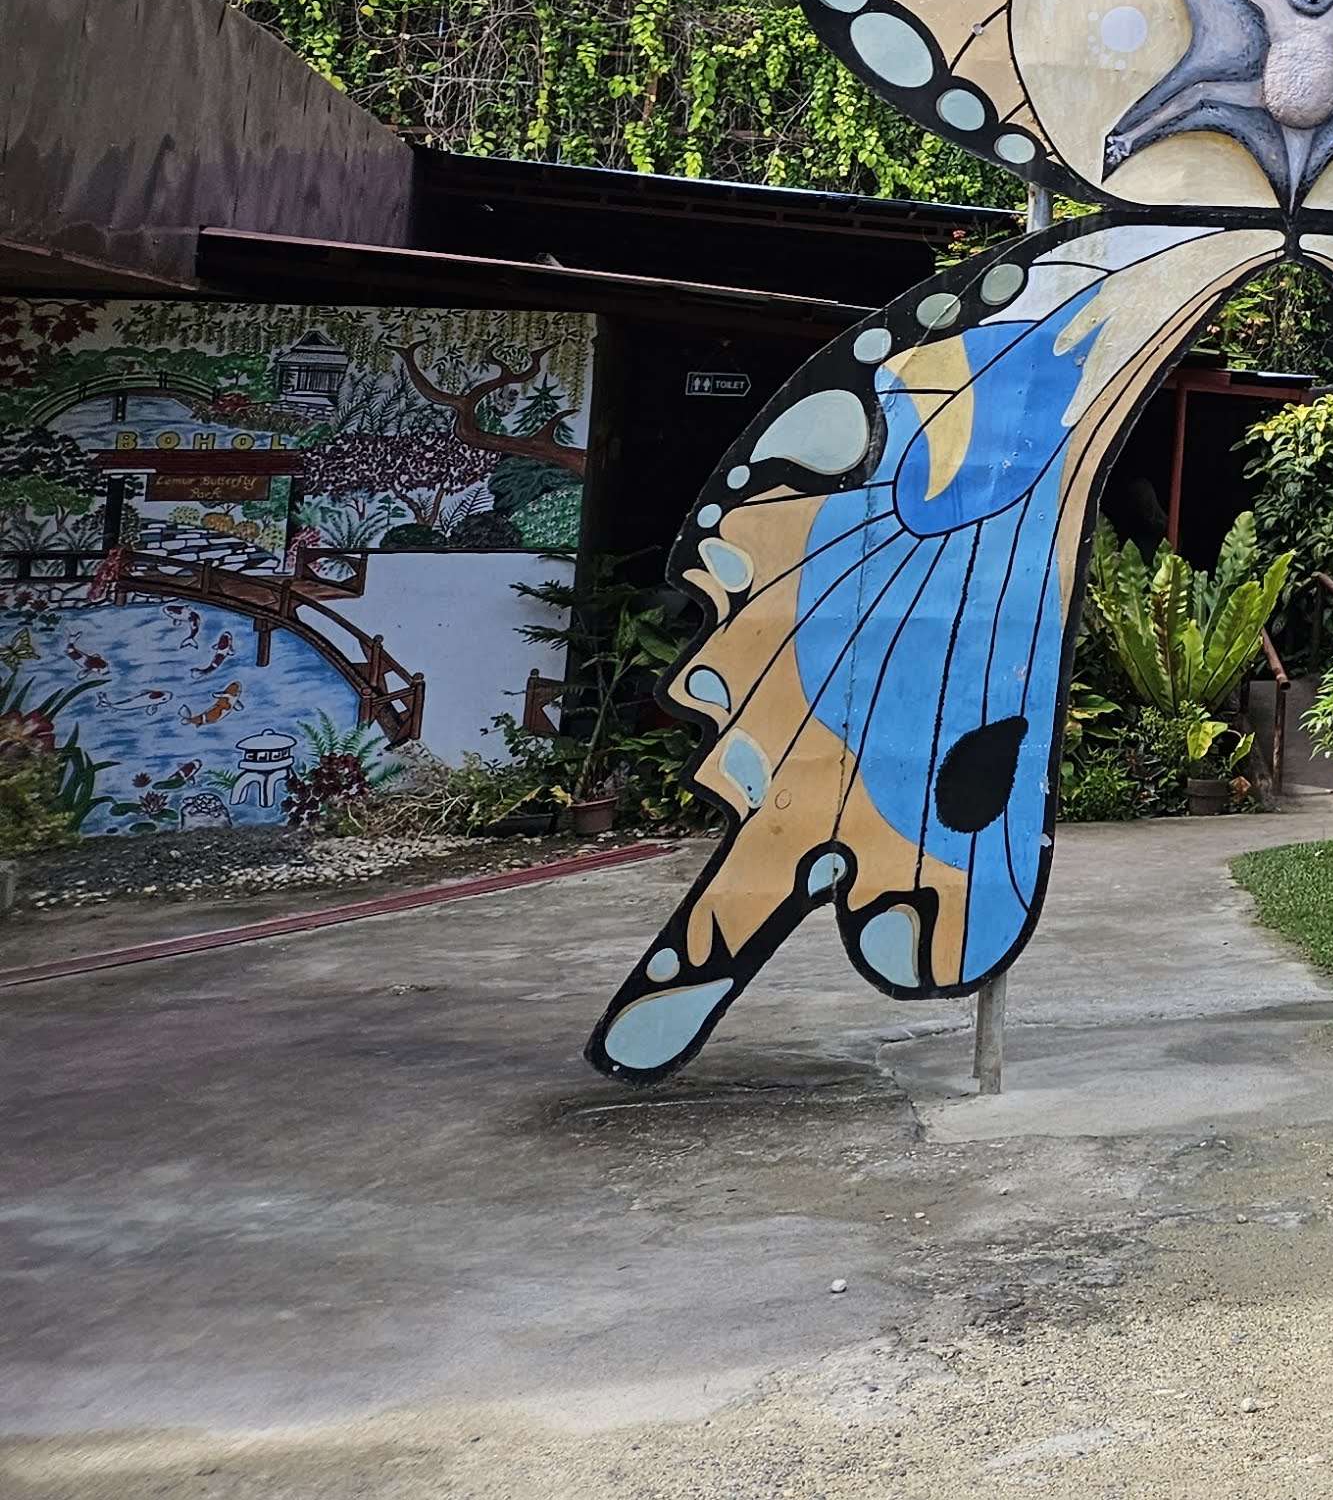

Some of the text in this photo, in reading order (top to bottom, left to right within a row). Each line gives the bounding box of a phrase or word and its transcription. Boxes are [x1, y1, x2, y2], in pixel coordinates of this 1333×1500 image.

[715, 380, 745, 389] TOILET
[115, 431, 287, 450] BOHOL
[155, 475, 258, 490] Lemur Butterfly
